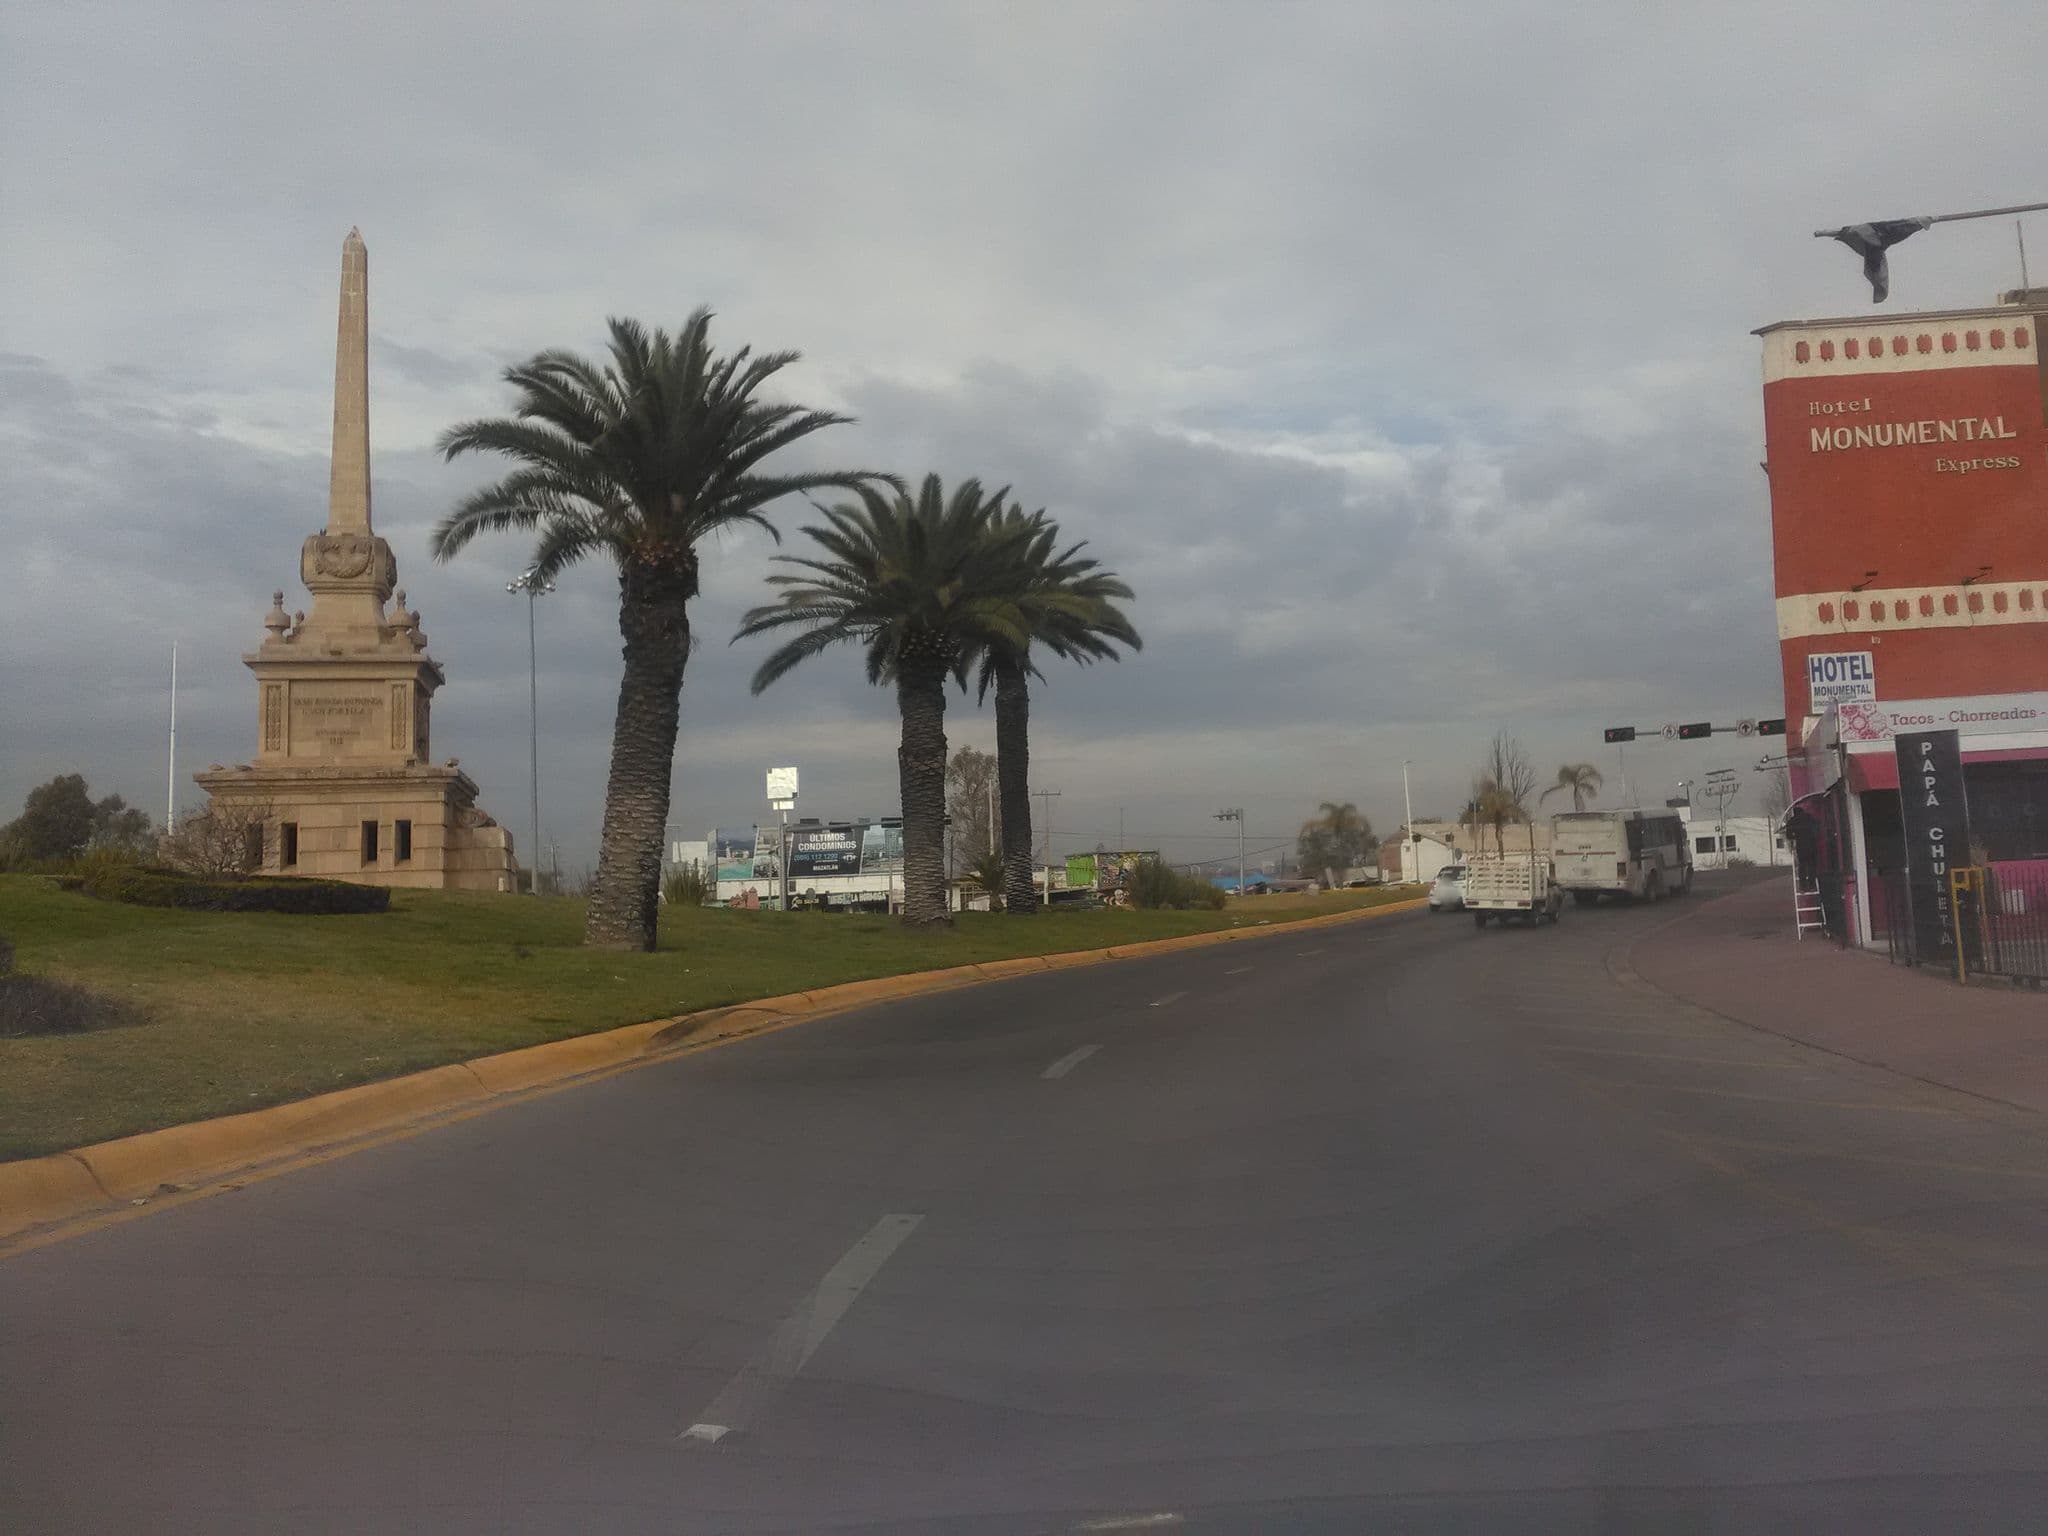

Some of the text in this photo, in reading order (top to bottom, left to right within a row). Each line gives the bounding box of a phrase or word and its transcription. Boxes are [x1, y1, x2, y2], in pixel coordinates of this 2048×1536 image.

[1809, 398, 1873, 416] Hotel
[1809, 416, 2017, 453] MONUMENTAL
[1936, 455, 2021, 475] Express
[1810, 654, 1873, 683] HOTEL
[1814, 684, 1871, 697] MONUMENTAL
[1890, 713, 1935, 726] Tacos
[1949, 707, 2037, 723] Chorreadas
[1921, 741, 1940, 807] PAPÁ
[798, 841, 857, 851] CONDOMINIOS
